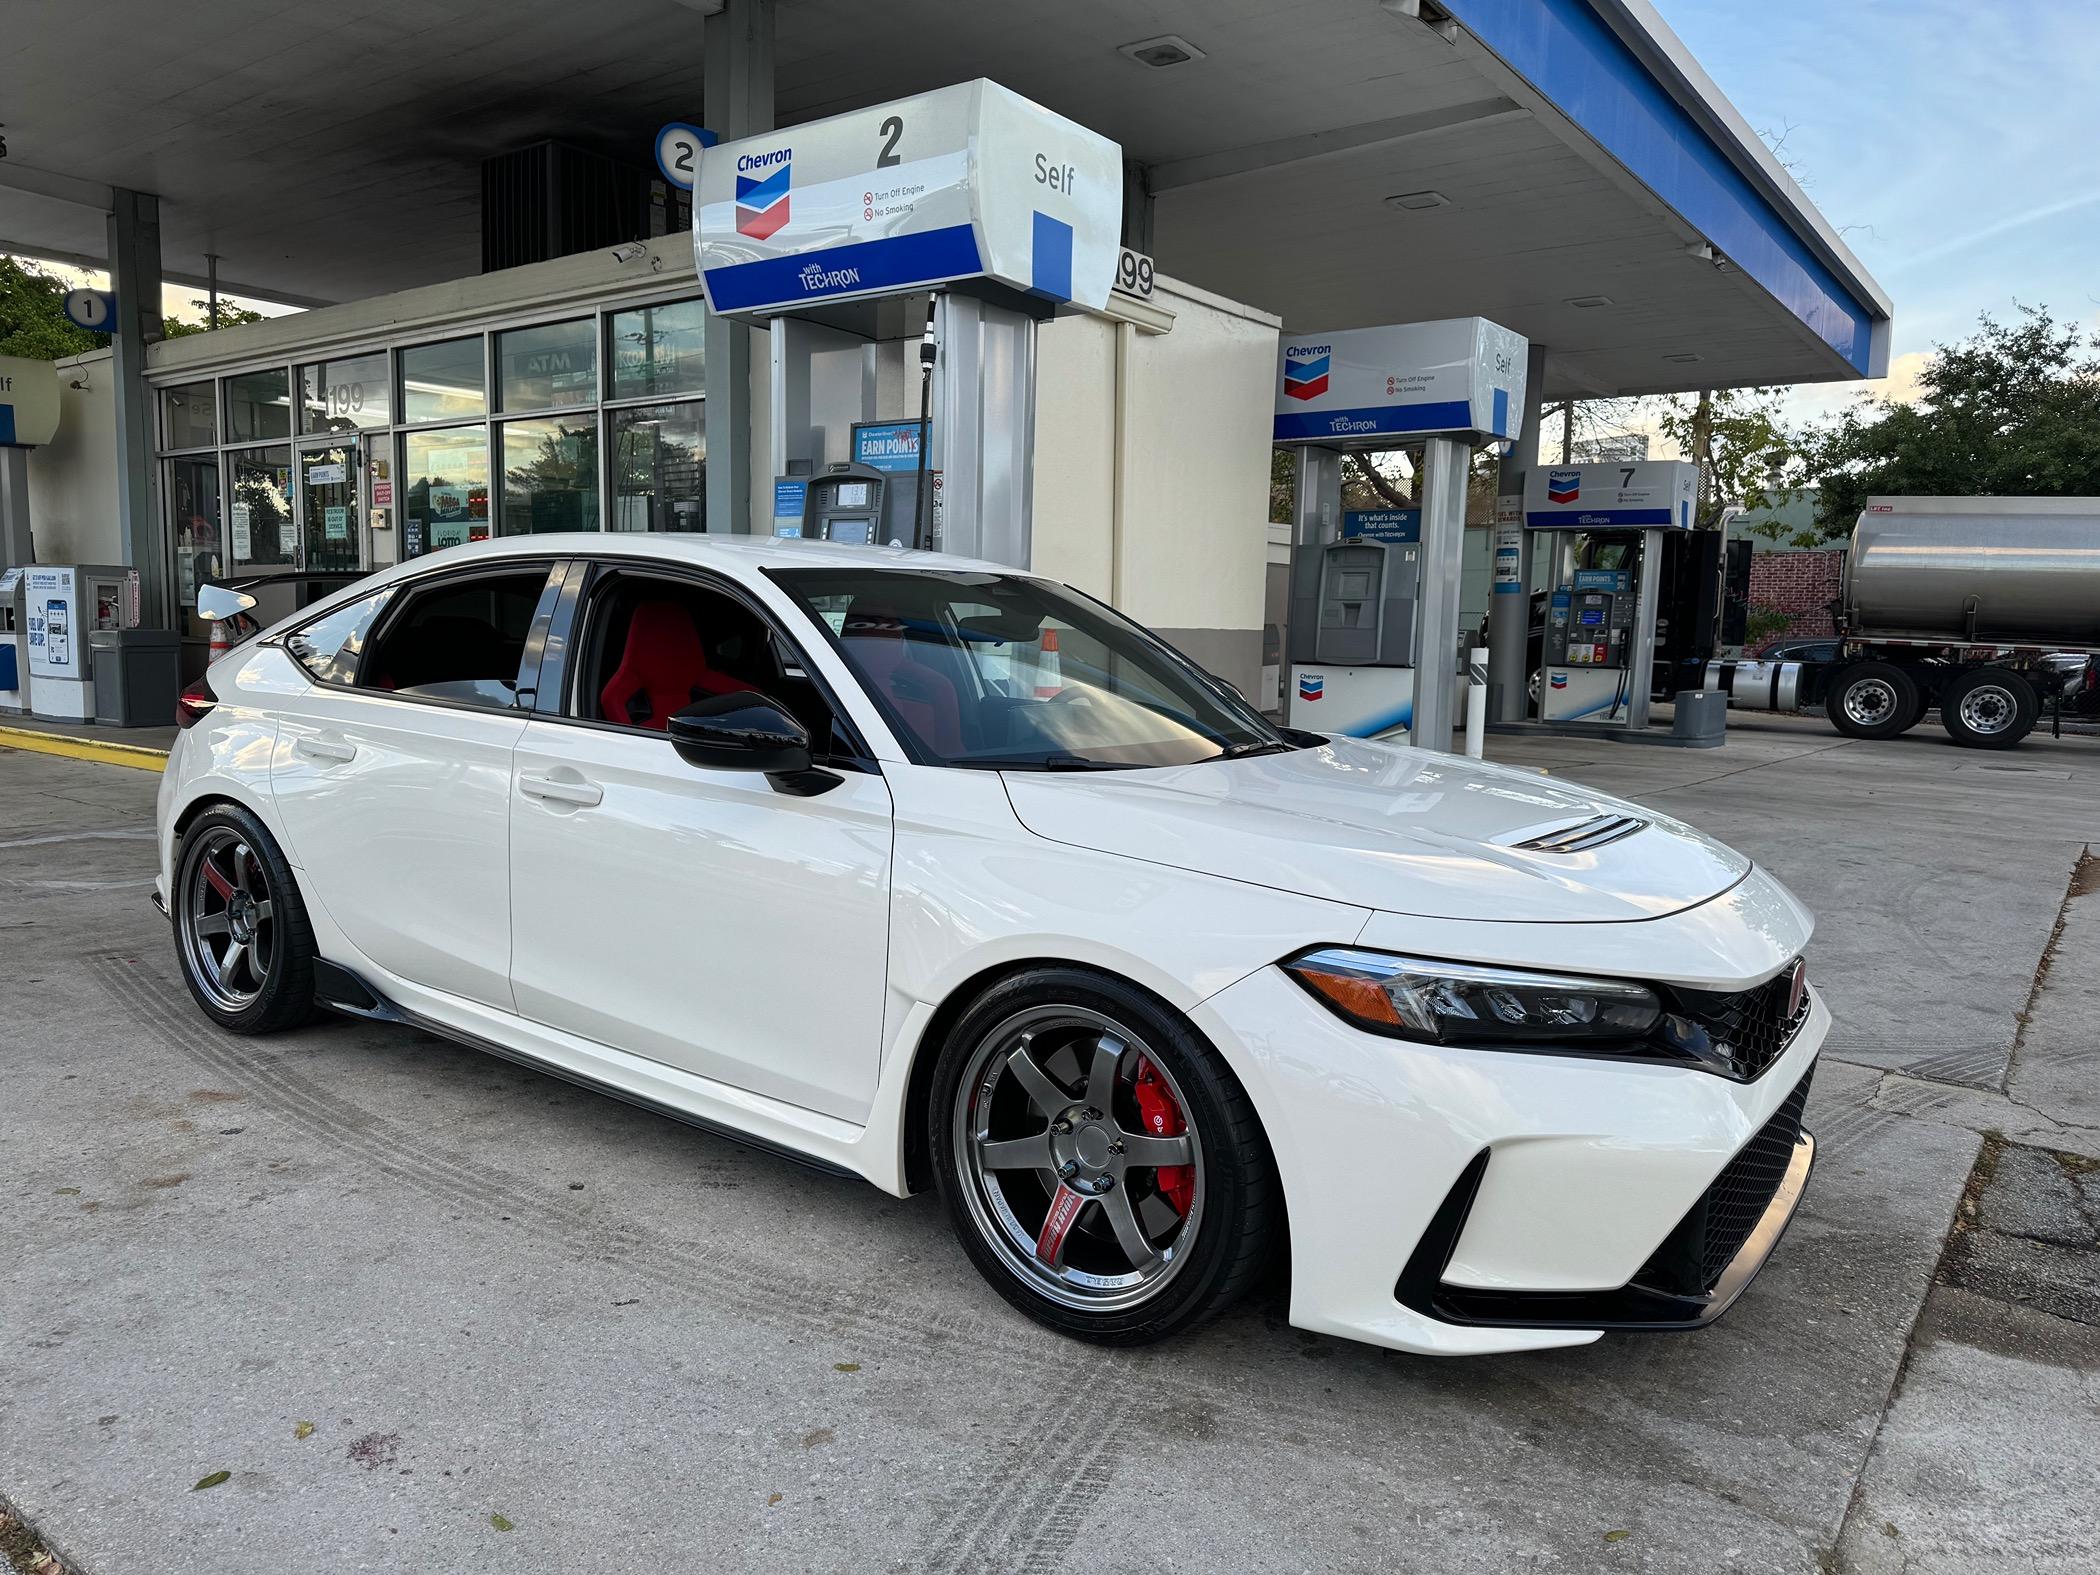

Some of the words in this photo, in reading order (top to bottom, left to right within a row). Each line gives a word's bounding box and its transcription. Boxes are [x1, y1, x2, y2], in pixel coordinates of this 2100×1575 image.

[877, 116, 904, 169] 2
[674, 141, 694, 173] 2
[738, 148, 792, 172] Chevron
[1034, 153, 1075, 196] Self
[874, 192, 889, 201] Turn
[890, 188, 901, 198] Off
[902, 184, 925, 196] Engine
[874, 208, 884, 217] No
[885, 203, 914, 216] Smoking
[803, 263, 822, 275] with
[798, 267, 861, 291] TECHRON
[83, 299, 93, 319] 1
[1286, 345, 1332, 358] Chevron
[1495, 353, 1512, 376] Self
[1417, 375, 1436, 383] Engine
[1403, 385, 1426, 393] Smoking
[1329, 420, 1377, 432] TECHRON
[861, 439, 886, 456] EARN
[886, 437, 919, 455] POINTS
[1549, 470, 1581, 478] Chevron
[1620, 467, 1636, 489] 7
[1358, 514, 1368, 522] It's
[1369, 513, 1388, 522] what's
[1389, 513, 1408, 521] inside
[1578, 517, 1610, 525] TECHRON
[1378, 521, 1400, 529] counts.
[437, 536, 461, 548] LOTTO
